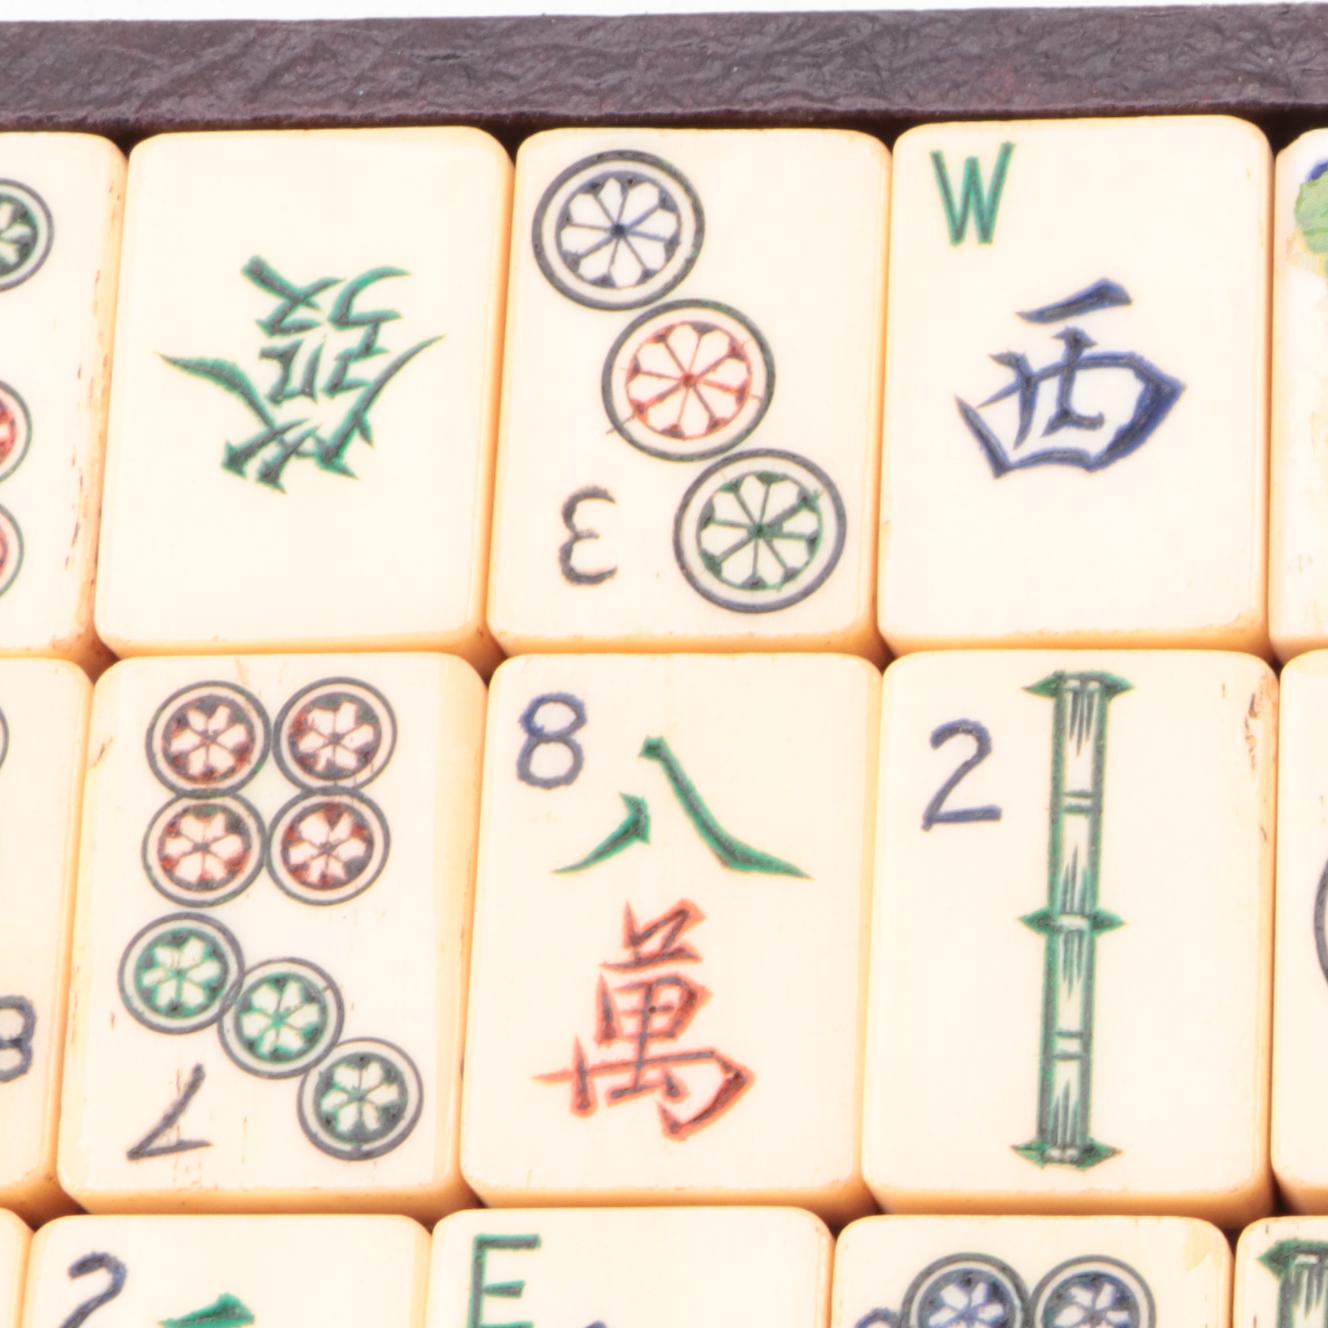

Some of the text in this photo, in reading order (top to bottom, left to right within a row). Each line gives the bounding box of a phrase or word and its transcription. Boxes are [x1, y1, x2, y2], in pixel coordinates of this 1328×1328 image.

[930, 142, 1015, 247] W
[160, 255, 444, 494] 發
[955, 278, 1186, 479] 西
[558, 486, 618, 586] 3
[516, 692, 587, 790] 8
[922, 719, 1002, 831] 2
[126, 1063, 212, 1160] 7
